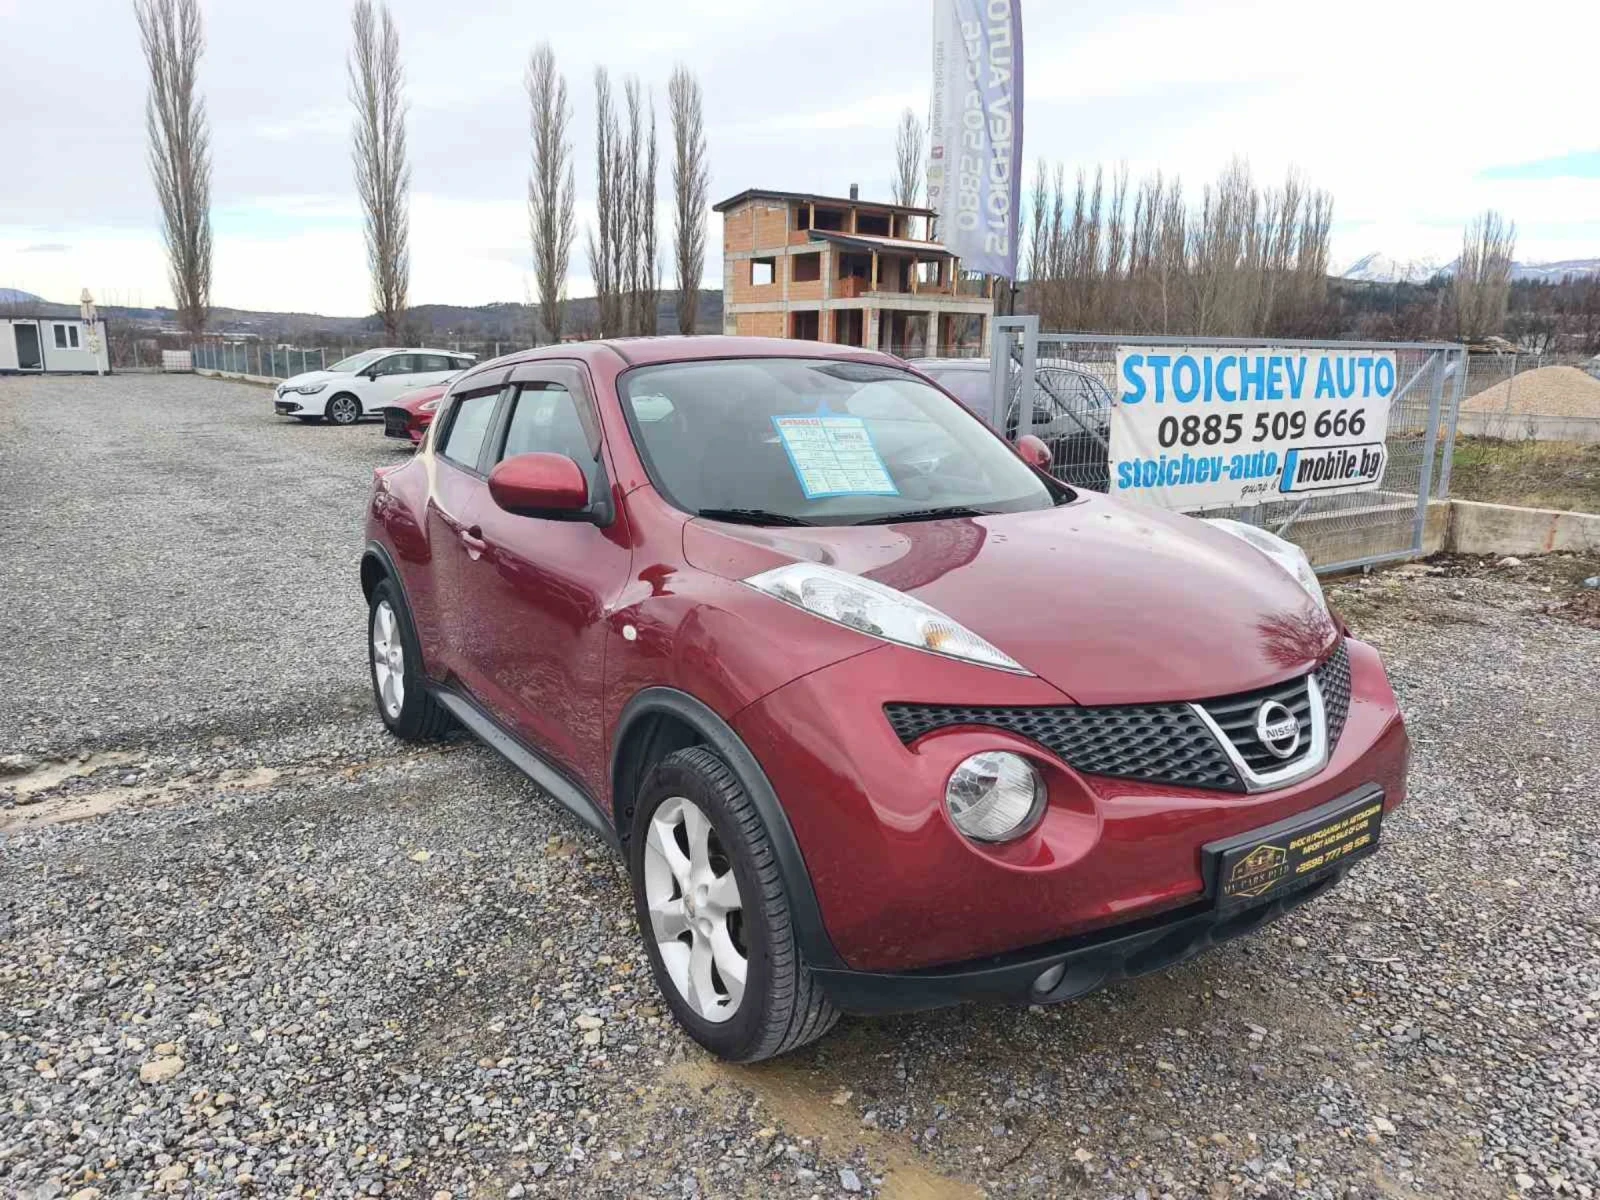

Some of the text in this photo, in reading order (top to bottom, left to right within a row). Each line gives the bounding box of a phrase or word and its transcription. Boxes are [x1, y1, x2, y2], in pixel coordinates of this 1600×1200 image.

[1121, 353, 1395, 404] STOICHEV AUTO
[1158, 408, 1366, 448] 0885 509 666
[1296, 448, 1381, 483] mobile.bg
[1266, 723, 1299, 739] NISSA
